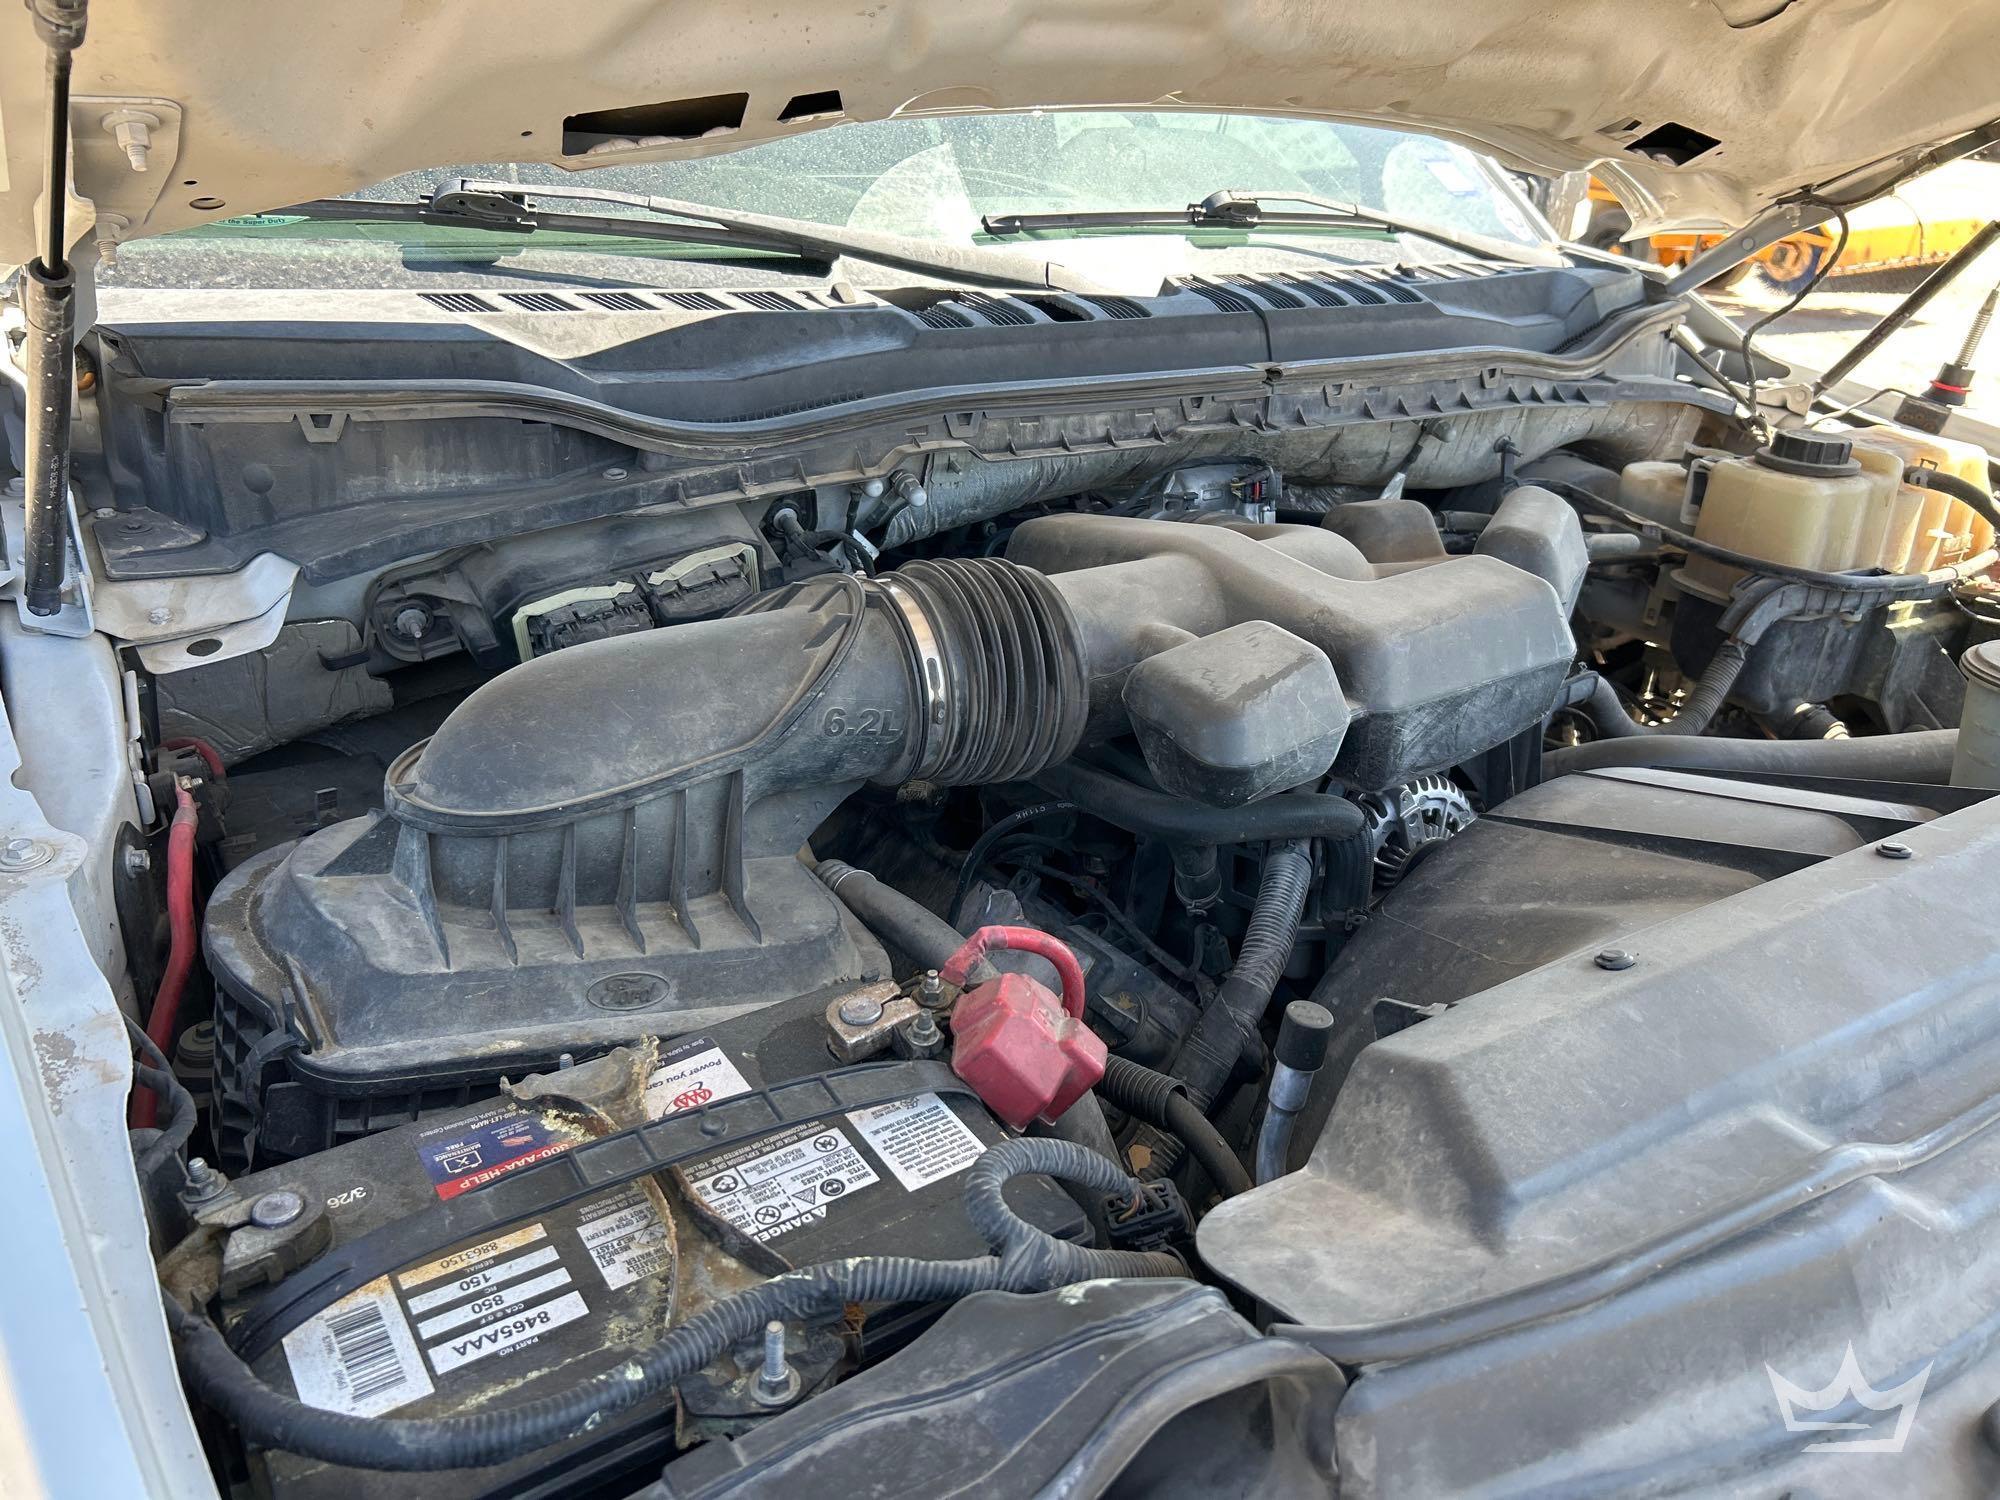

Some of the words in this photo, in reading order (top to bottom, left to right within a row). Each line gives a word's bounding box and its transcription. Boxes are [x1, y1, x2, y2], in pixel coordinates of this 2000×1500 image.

[823, 706, 902, 739] 6.2L
[685, 1057, 723, 1075] Power
[663, 1071, 687, 1084] you
[327, 1187, 367, 1209] 3/26
[437, 1239, 499, 1271] 8863150
[595, 1243, 632, 1262] MEDICAL
[598, 1256, 616, 1268] GET
[456, 1270, 493, 1293] 150
[468, 1292, 505, 1316] 850
[450, 1307, 552, 1359] 8465AAA
[513, 1335, 539, 1350] PART
